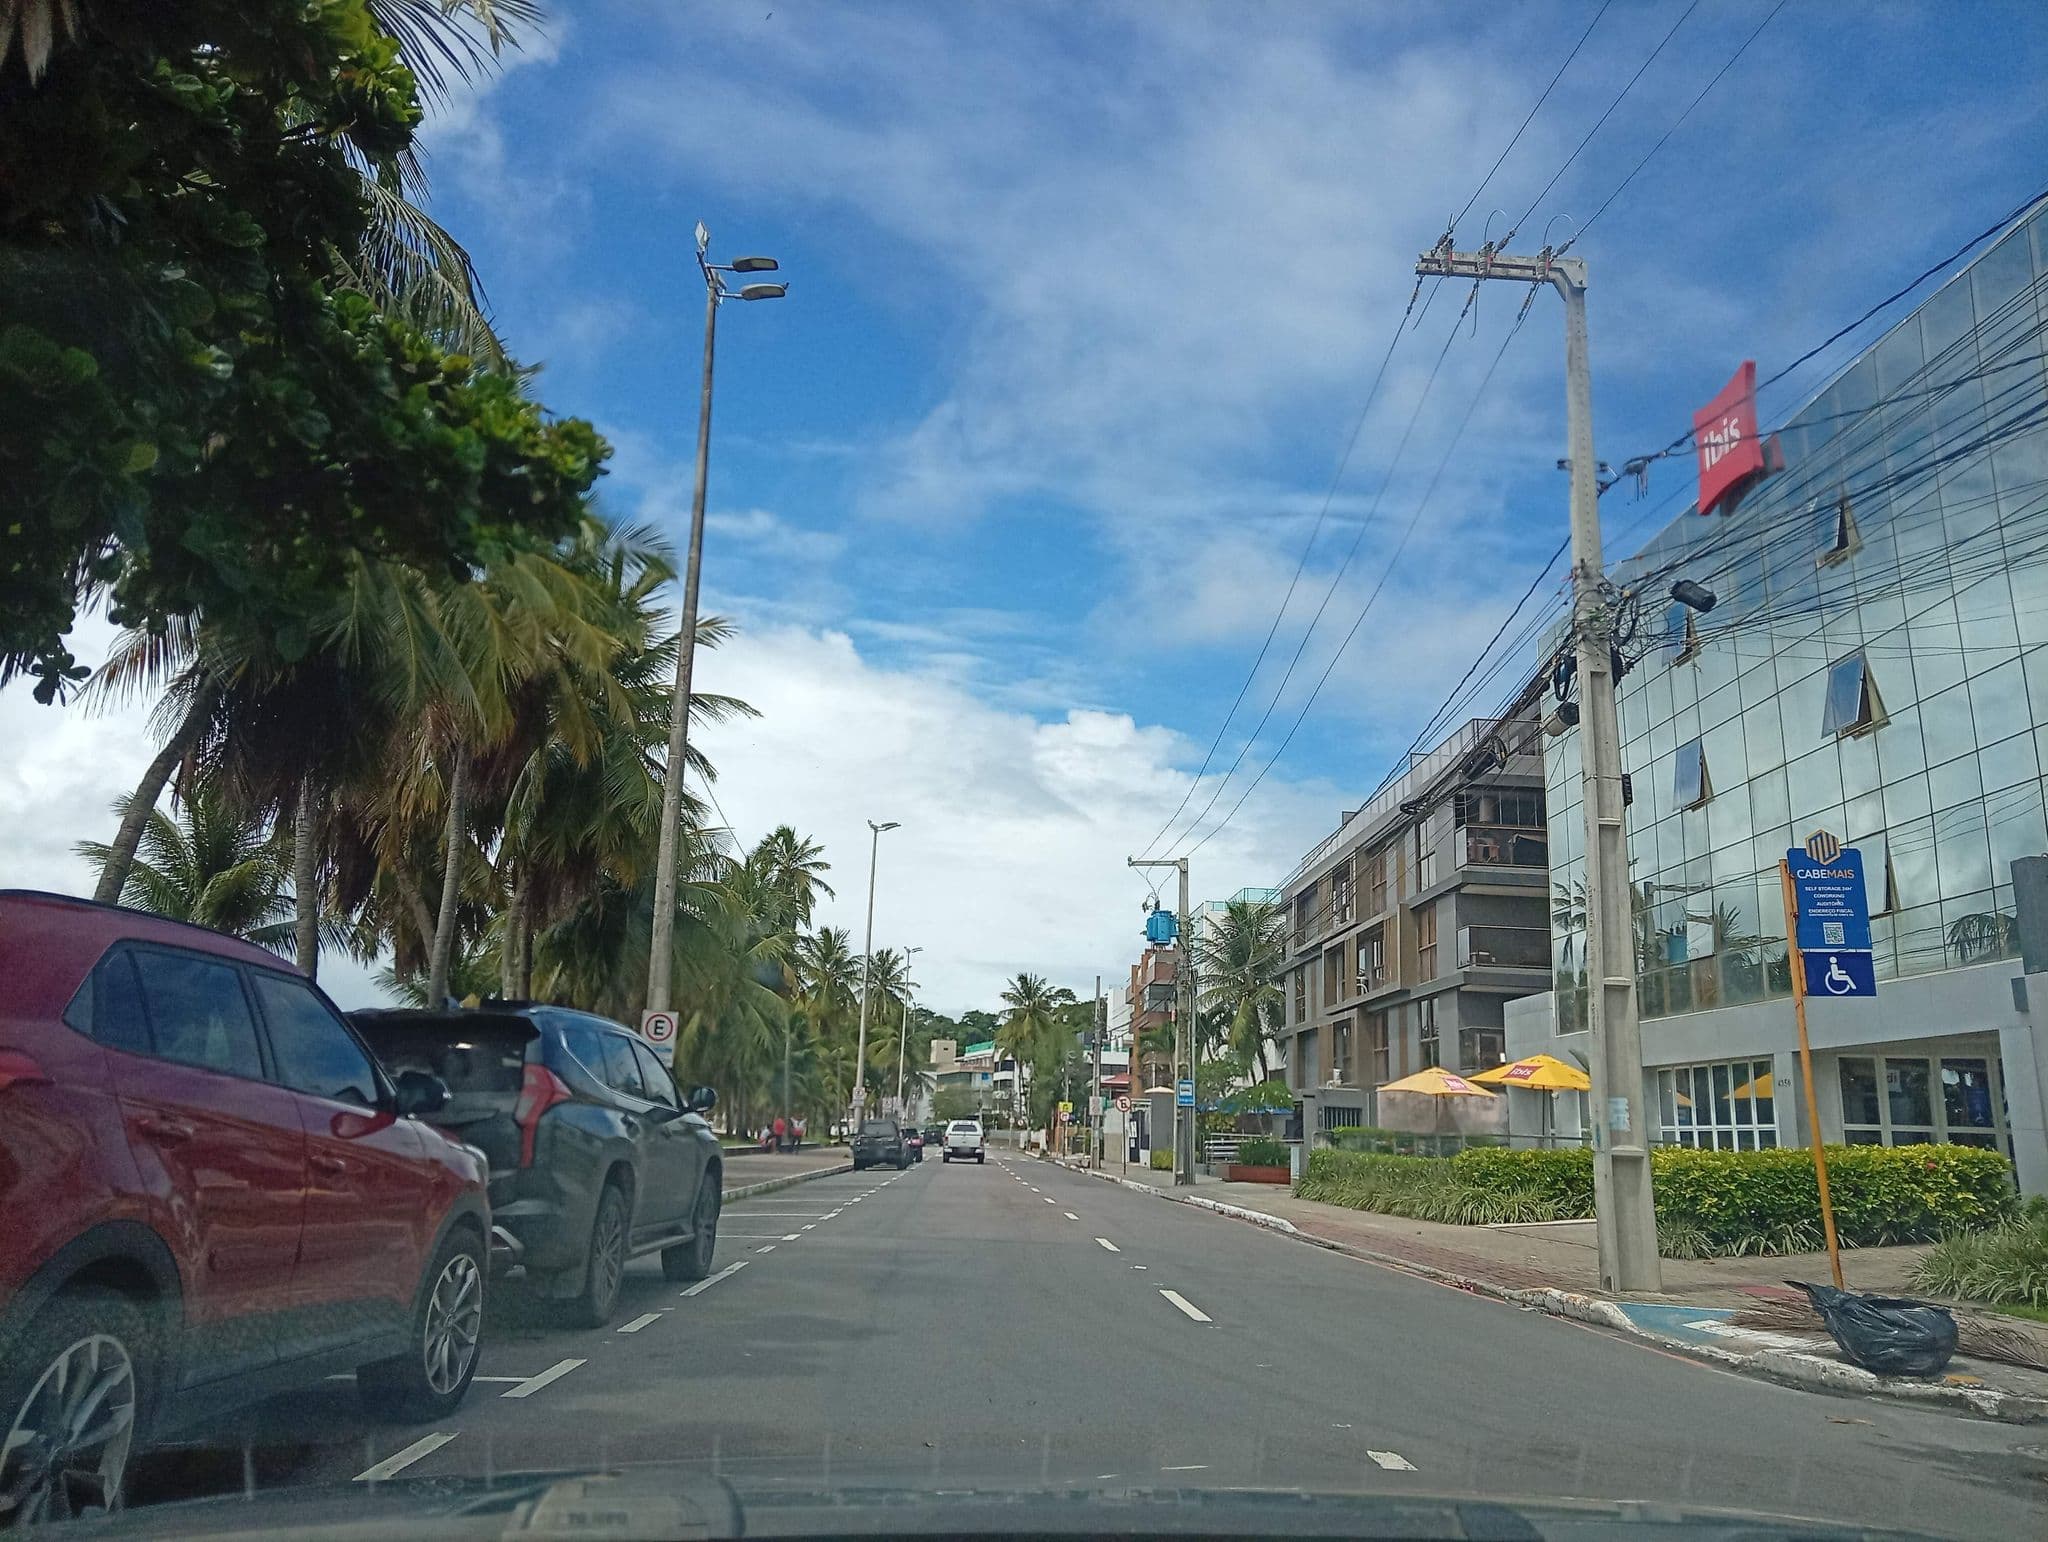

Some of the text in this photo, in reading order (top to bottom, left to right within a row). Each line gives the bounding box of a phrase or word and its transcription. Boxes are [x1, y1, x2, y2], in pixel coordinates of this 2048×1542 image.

[1703, 416, 1741, 473] ibis
[1796, 869, 1855, 879] CABEMAIS
[654, 1019, 665, 1036] E
[1510, 1067, 1533, 1076] ibis
